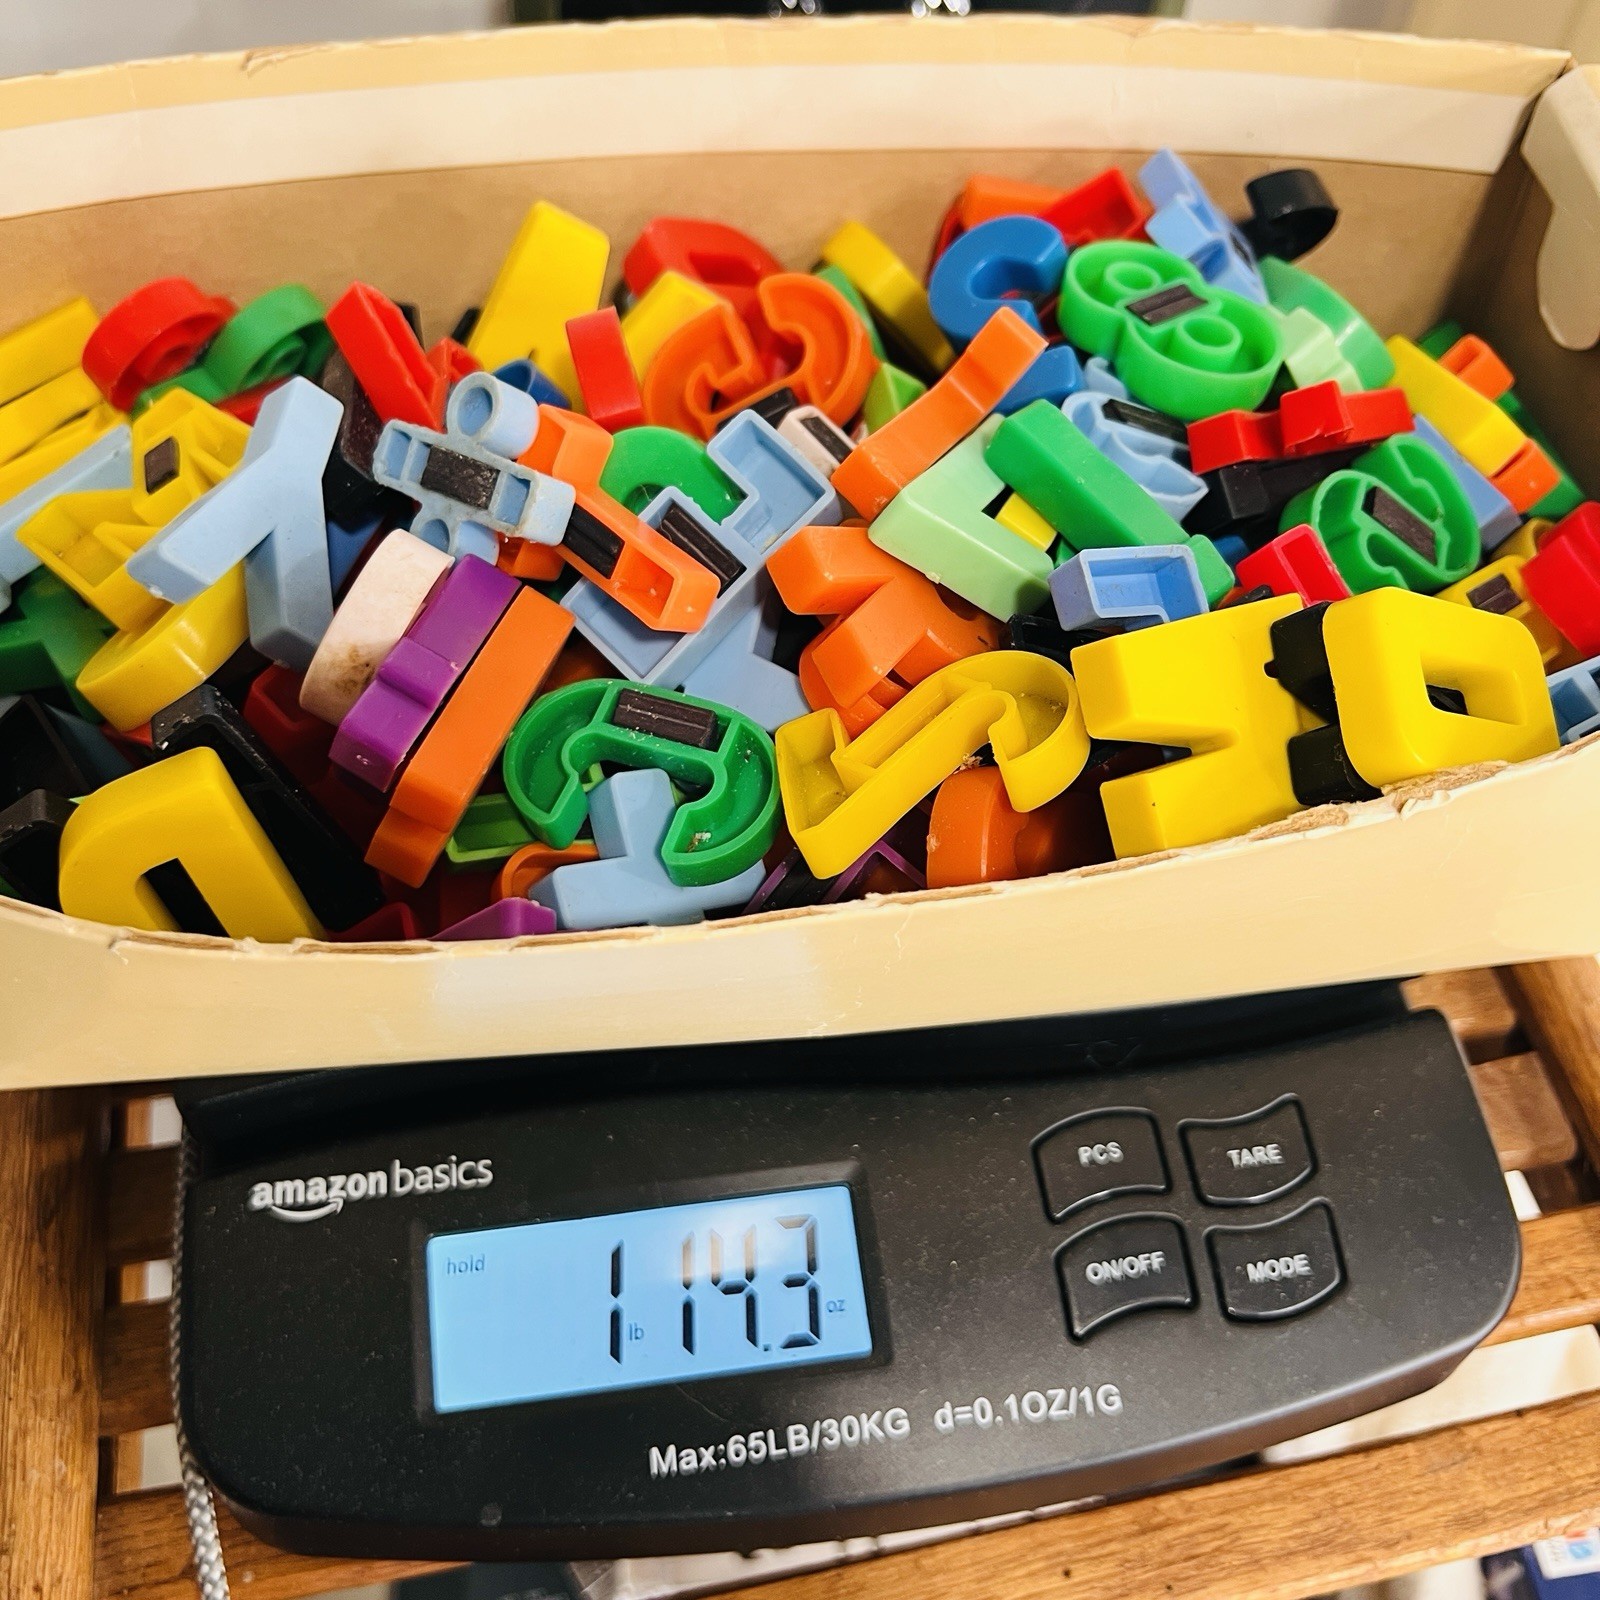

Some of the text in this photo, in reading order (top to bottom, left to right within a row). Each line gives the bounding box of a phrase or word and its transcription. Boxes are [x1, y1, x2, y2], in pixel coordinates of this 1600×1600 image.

[1078, 1141, 1124, 1167] PCS
[1227, 1143, 1285, 1169] TARE
[390, 1155, 494, 1198] basics
[446, 1254, 486, 1275] hold
[1085, 1250, 1167, 1286] ON/OFF
[1246, 1253, 1313, 1284] MODE
[826, 1298, 847, 1314] oz
[648, 1407, 911, 1479] Max:65LB/30KG
